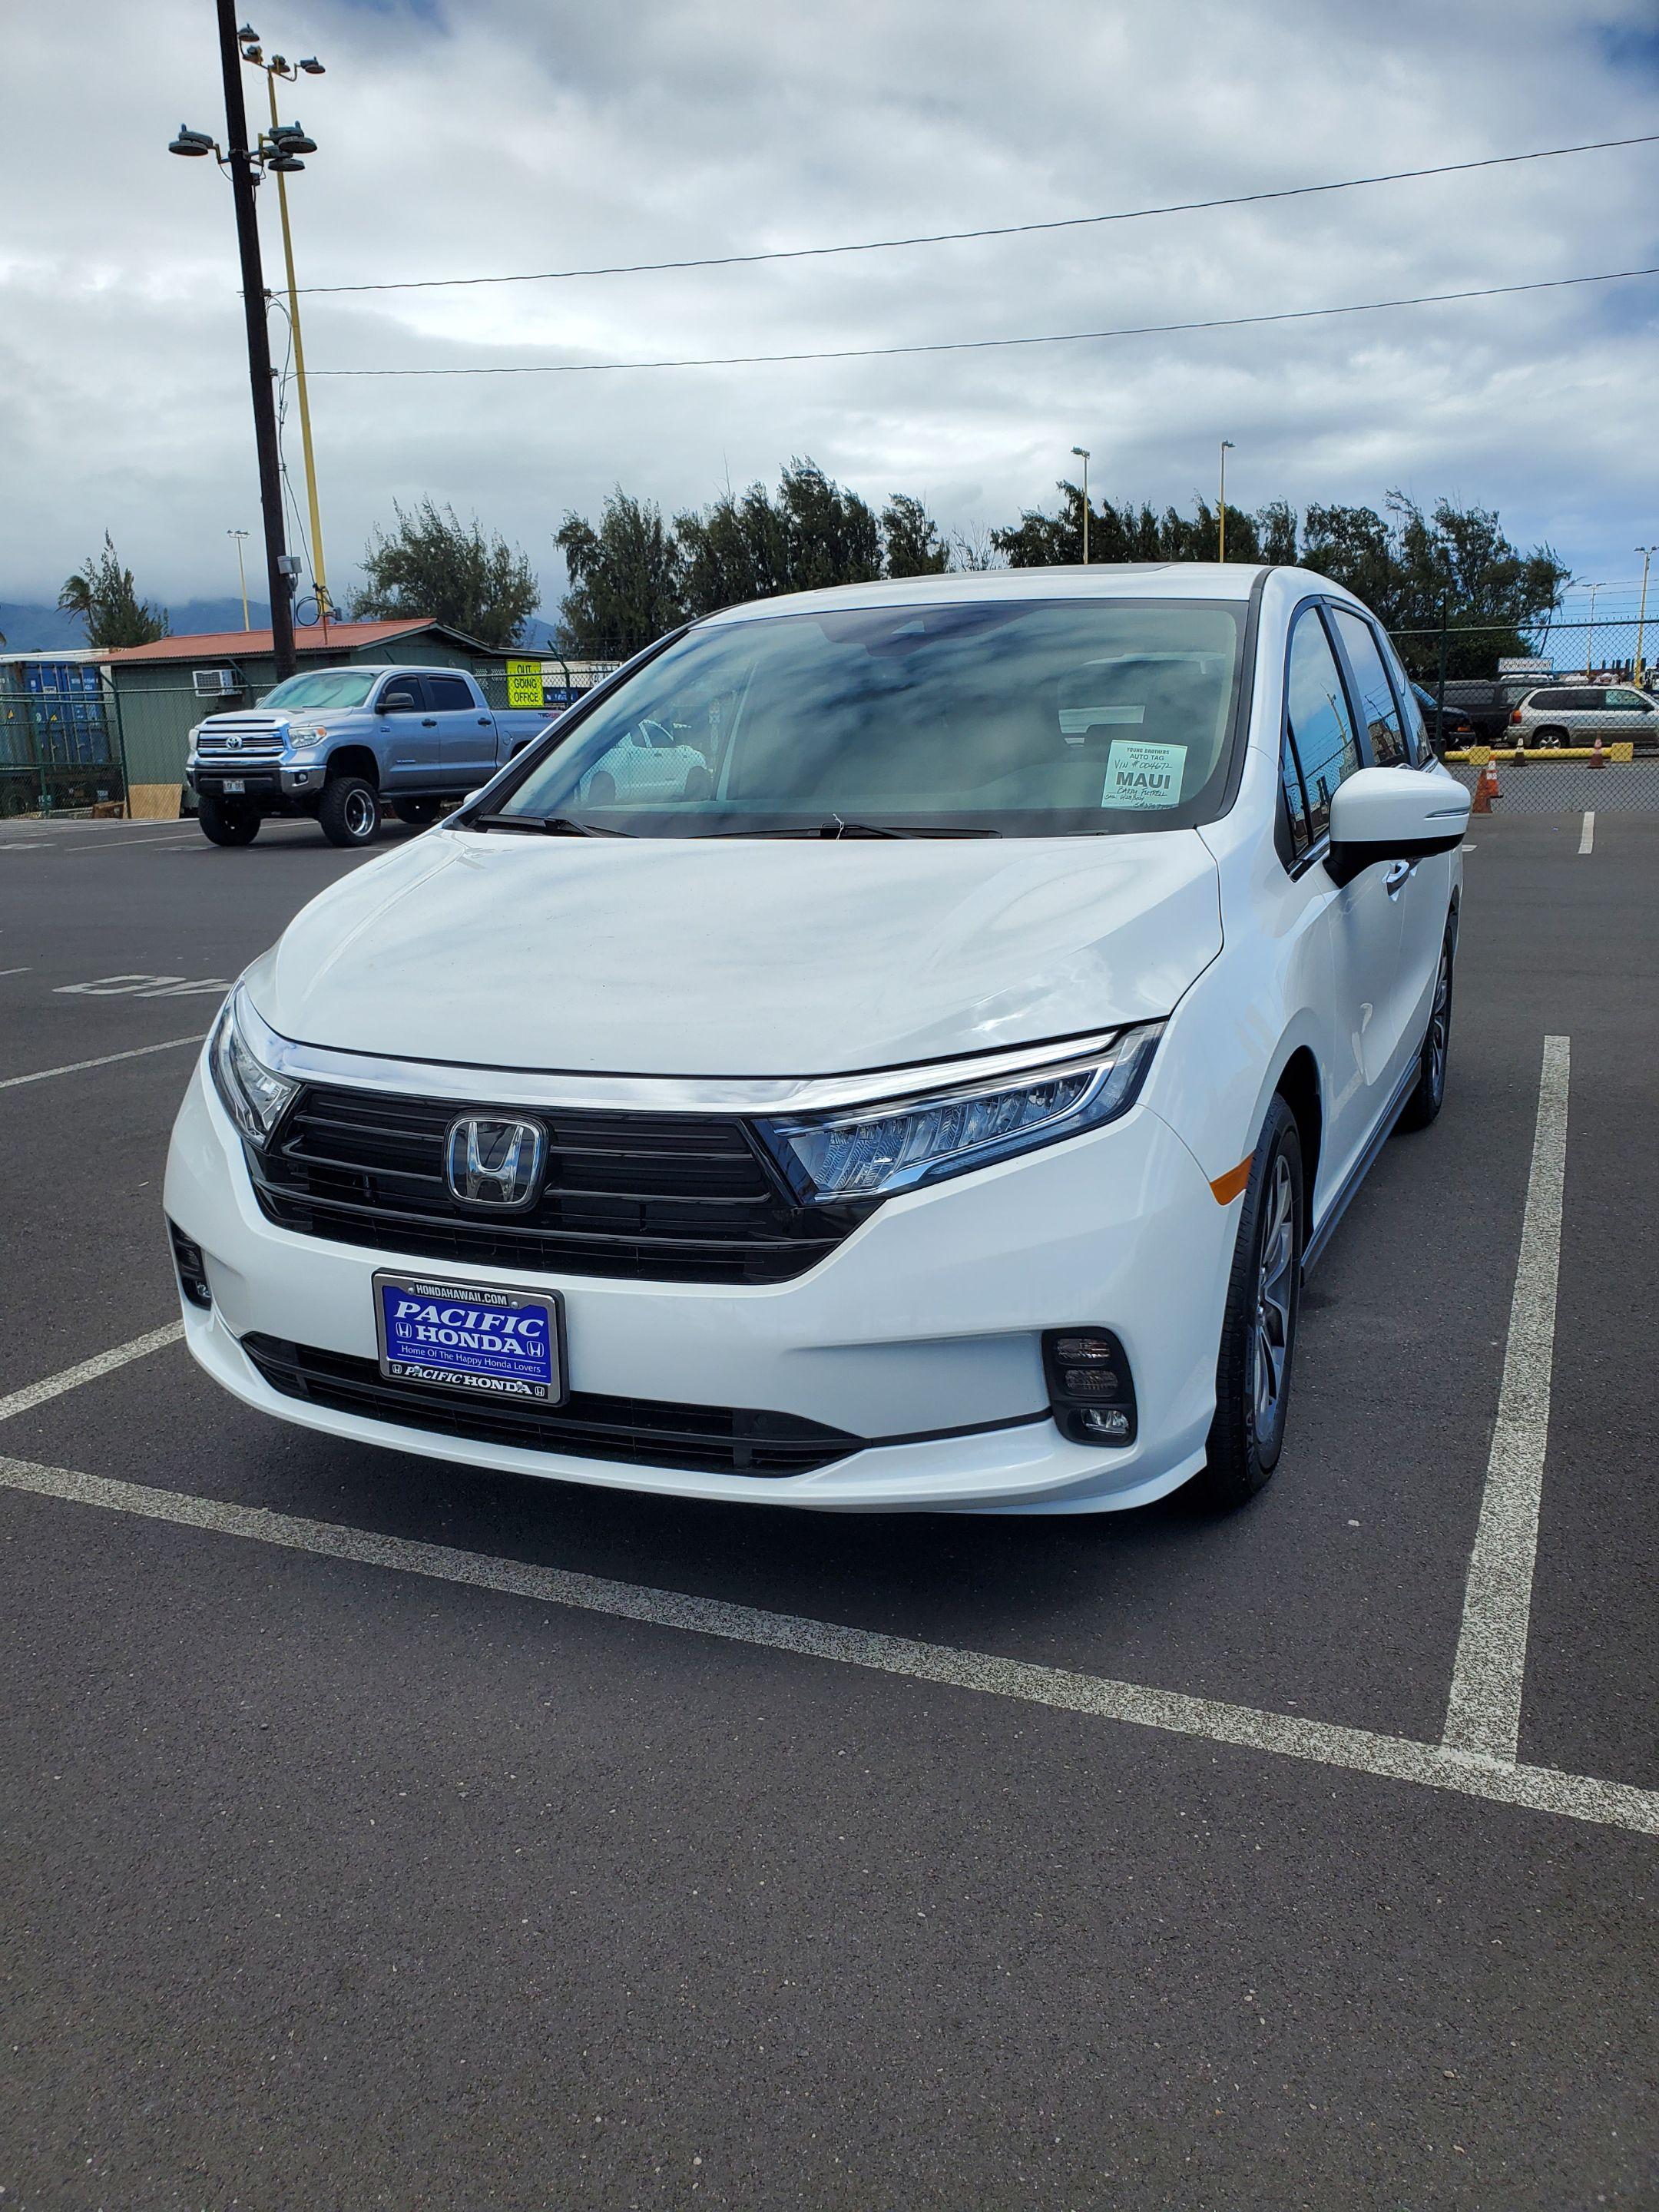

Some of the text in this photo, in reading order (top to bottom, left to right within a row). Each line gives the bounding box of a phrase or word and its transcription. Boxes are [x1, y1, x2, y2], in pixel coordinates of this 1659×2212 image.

[517, 664, 532, 674] OUT
[514, 677, 538, 688] GOING
[513, 692, 539, 703] OFFICE
[1114, 759, 1129, 769] VIN
[1116, 771, 1171, 789] MAUI
[416, 1283, 508, 1306] HONDAHAWAII.COM
[393, 1300, 545, 1337] PACIFIC
[415, 1324, 526, 1356] HONDA
[401, 1344, 541, 1373] Home Of The Happy Honda Lovers
[404, 1366, 533, 1395] PACIFIC HONDA
